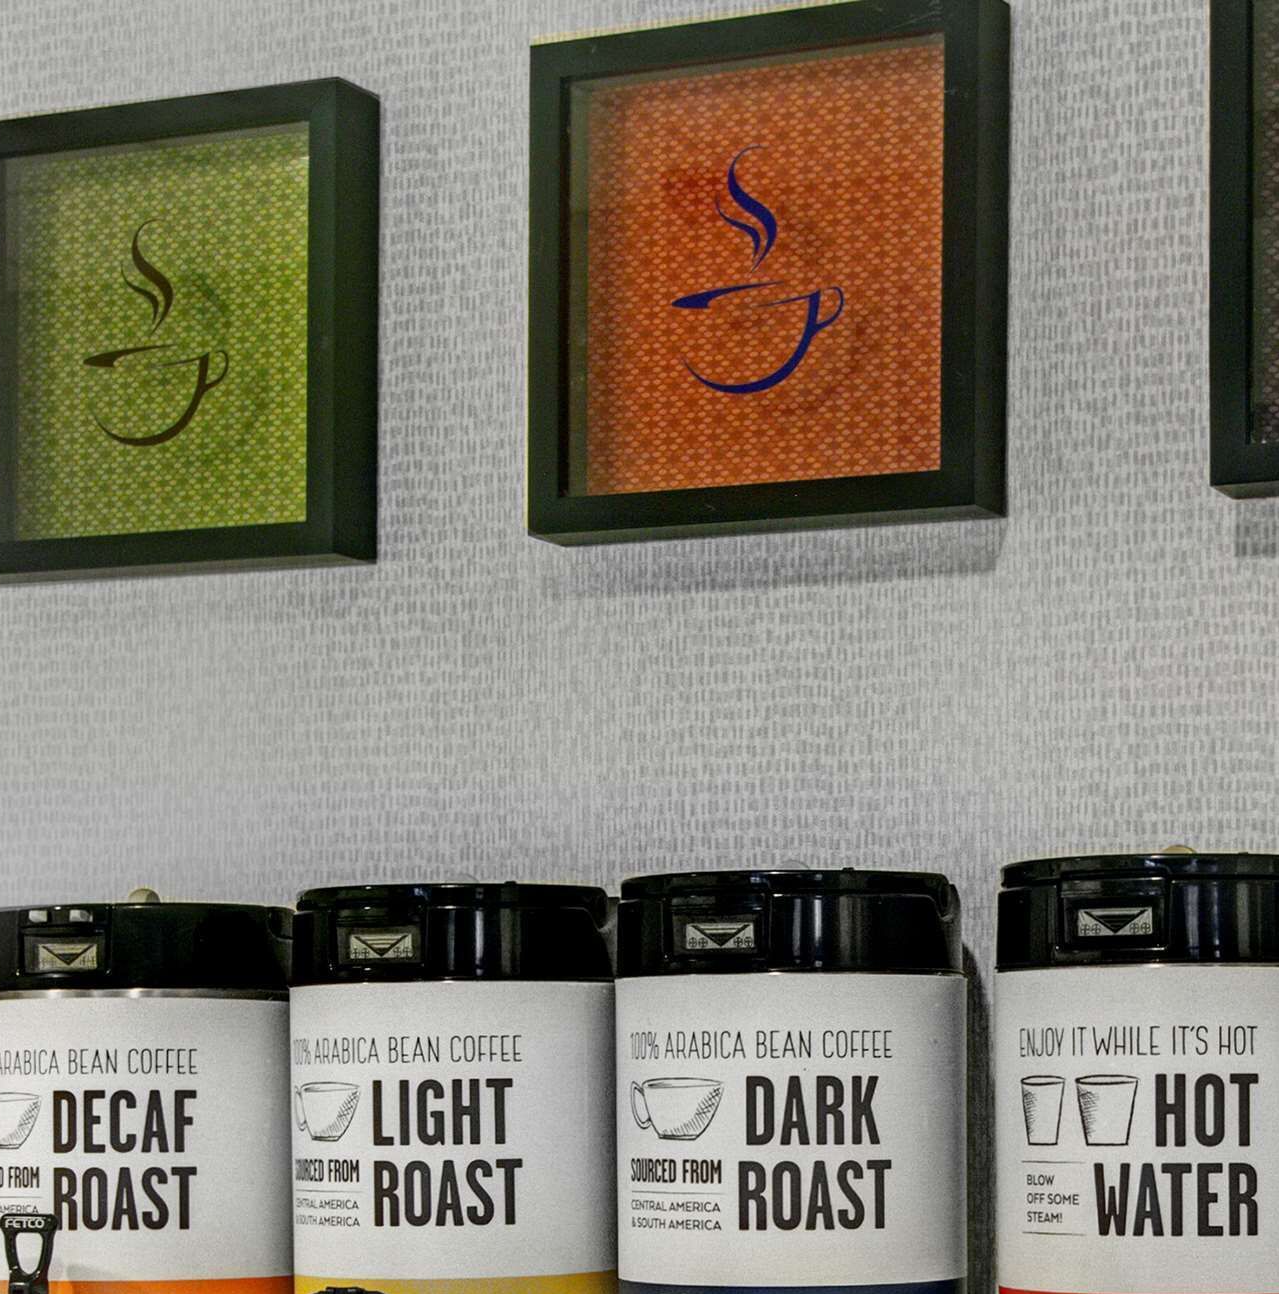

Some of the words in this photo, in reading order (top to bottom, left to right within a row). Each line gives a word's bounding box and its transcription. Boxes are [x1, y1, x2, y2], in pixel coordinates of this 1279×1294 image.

[314, 1037, 380, 1065] ARABICA
[388, 1036, 440, 1064] BEAN
[450, 1034, 523, 1062] COFFEE
[630, 1031, 659, 1060] 100%
[664, 1031, 746, 1060] ARABICA
[756, 1030, 812, 1059] BEAN
[822, 1030, 893, 1059] COFFEE
[1019, 1027, 1064, 1057] ENJOY
[1072, 1026, 1087, 1056] IT
[1092, 1026, 1161, 1056] WHILE
[1172, 1025, 1209, 1056] IT'S
[1219, 1025, 1258, 1056] HOT
[68, 1048, 118, 1075] BEAN
[127, 1048, 198, 1075] COFFEE
[52, 1089, 197, 1153] DECAF
[372, 1078, 513, 1146] LIGHT
[746, 1075, 880, 1145] DARK
[1155, 1073, 1259, 1147] HOT
[8, 1166, 40, 1189] FROM
[328, 1159, 360, 1183] FROM
[631, 1158, 677, 1184] SOURCED
[682, 1159, 722, 1184] FROM
[1026, 1174, 1055, 1186] BLOW
[53, 1166, 198, 1231] ROAST
[318, 1199, 359, 1211] AMERICA
[373, 1158, 523, 1227] ROAST
[631, 1199, 668, 1212] CENTRAL
[669, 1200, 721, 1213] AMERICA
[738, 1159, 892, 1231] ROAST
[1026, 1193, 1045, 1204] OFF
[1047, 1193, 1080, 1205] SOME
[1093, 1162, 1259, 1237] WATER
[4, 1217, 45, 1228] FETCO
[318, 1216, 360, 1228] AMERICA
[668, 1219, 722, 1231] AMERICA
[1026, 1211, 1063, 1223] STEAM!
